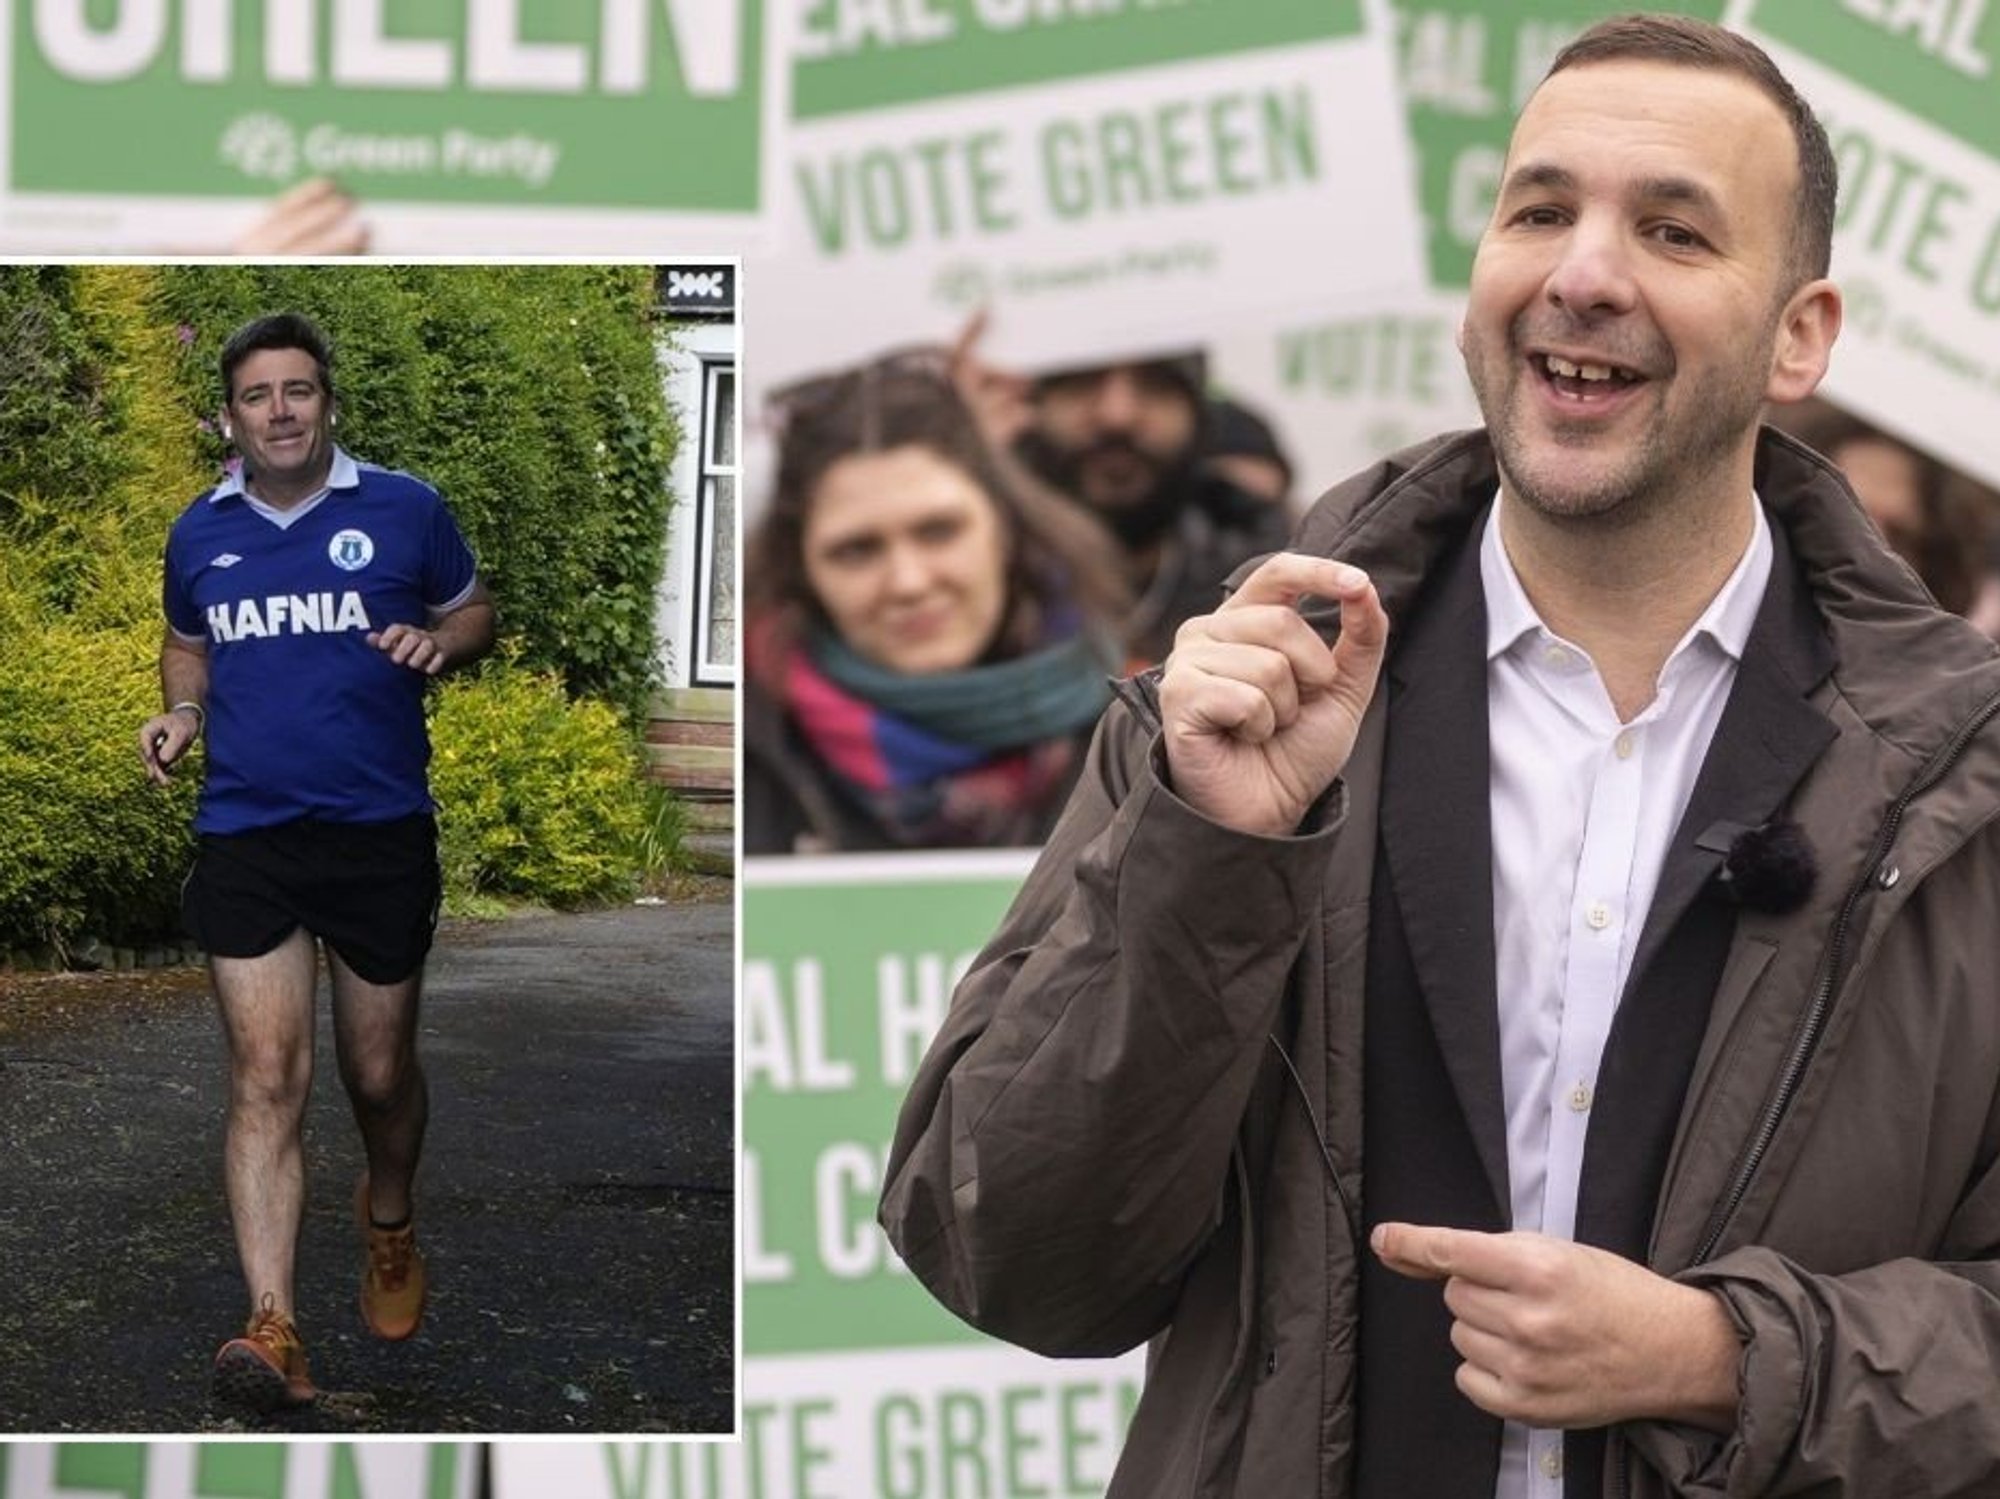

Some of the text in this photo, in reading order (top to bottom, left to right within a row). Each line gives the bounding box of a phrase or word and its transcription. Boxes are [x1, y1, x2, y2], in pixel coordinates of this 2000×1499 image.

[303, 123, 558, 189] Green Party
[794, 88, 1317, 255] VOTE GREEN
[1822, 112, 1969, 286] OTE
[206, 591, 371, 643] HAFNIA
